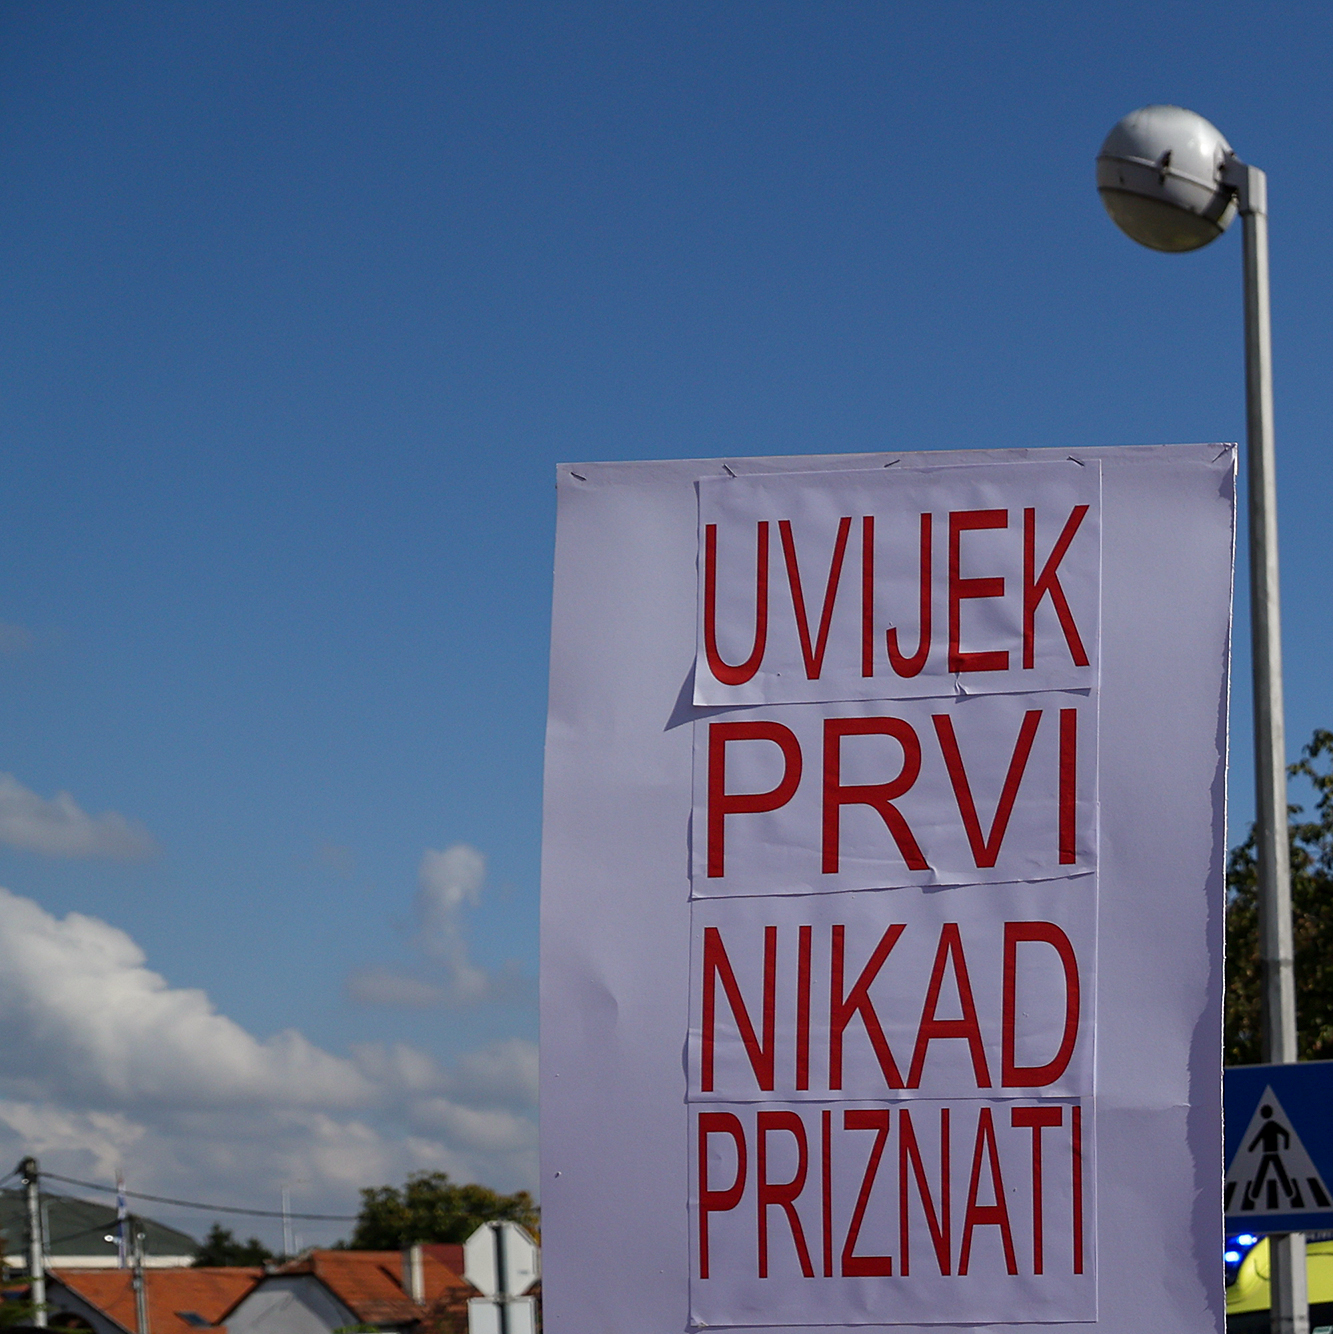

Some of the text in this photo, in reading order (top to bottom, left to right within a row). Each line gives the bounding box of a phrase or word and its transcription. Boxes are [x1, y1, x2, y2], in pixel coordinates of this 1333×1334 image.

[705, 506, 1088, 685] UVIJEK
[708, 709, 1076, 877] PRVI
[702, 922, 1079, 1091] NIKAD
[700, 1107, 1082, 1278] PRIZNATI
